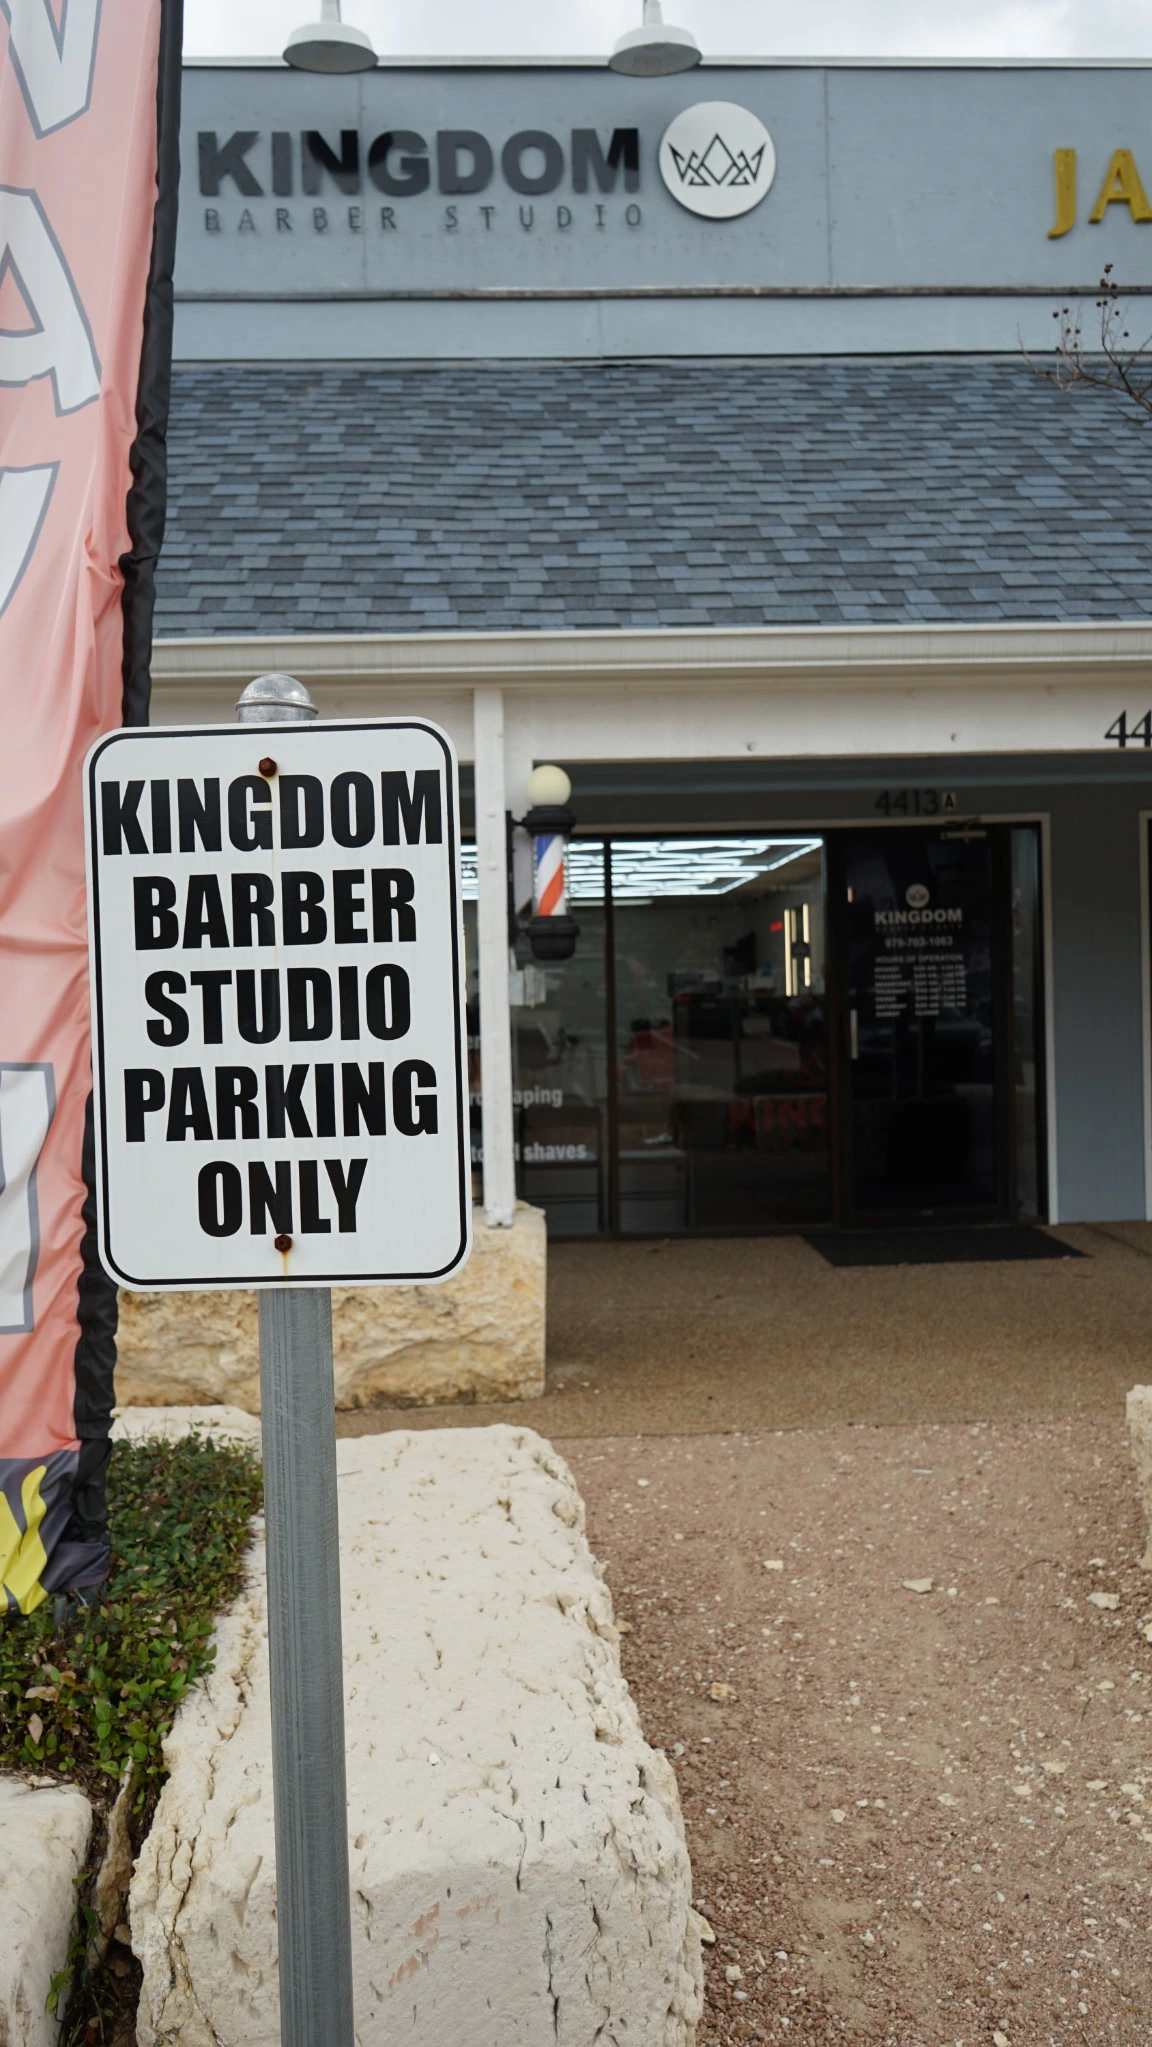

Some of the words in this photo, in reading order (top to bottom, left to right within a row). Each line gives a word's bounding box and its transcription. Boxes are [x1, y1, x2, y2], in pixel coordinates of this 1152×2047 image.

[197, 127, 641, 198] KINGDOM
[204, 206, 399, 235] BARBER
[444, 203, 643, 232] STUDIO
[101, 769, 444, 855] KINGDOM
[133, 868, 417, 951] BARBER
[874, 907, 963, 925] KINGDOM
[144, 963, 412, 1047] STUDIO
[124, 1059, 439, 1143] PARKING
[523, 1142, 587, 1162] shaves
[198, 1158, 369, 1238] ONLY
